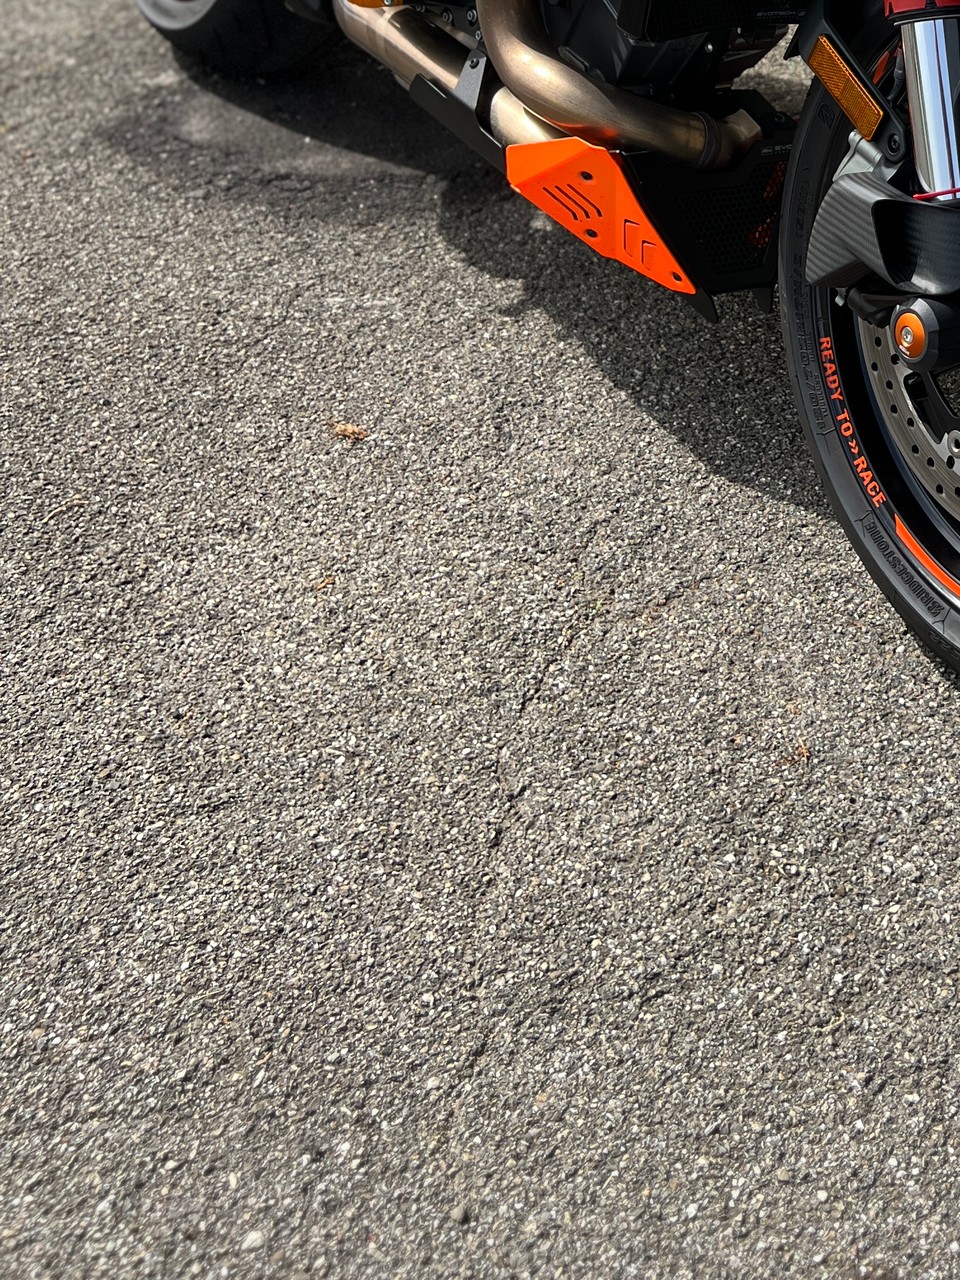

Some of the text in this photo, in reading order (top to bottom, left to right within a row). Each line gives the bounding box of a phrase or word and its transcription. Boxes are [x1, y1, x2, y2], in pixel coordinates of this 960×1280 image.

[819, 336, 887, 508] READY TO RACE
[863, 517, 946, 618] BRIDGESTONE
